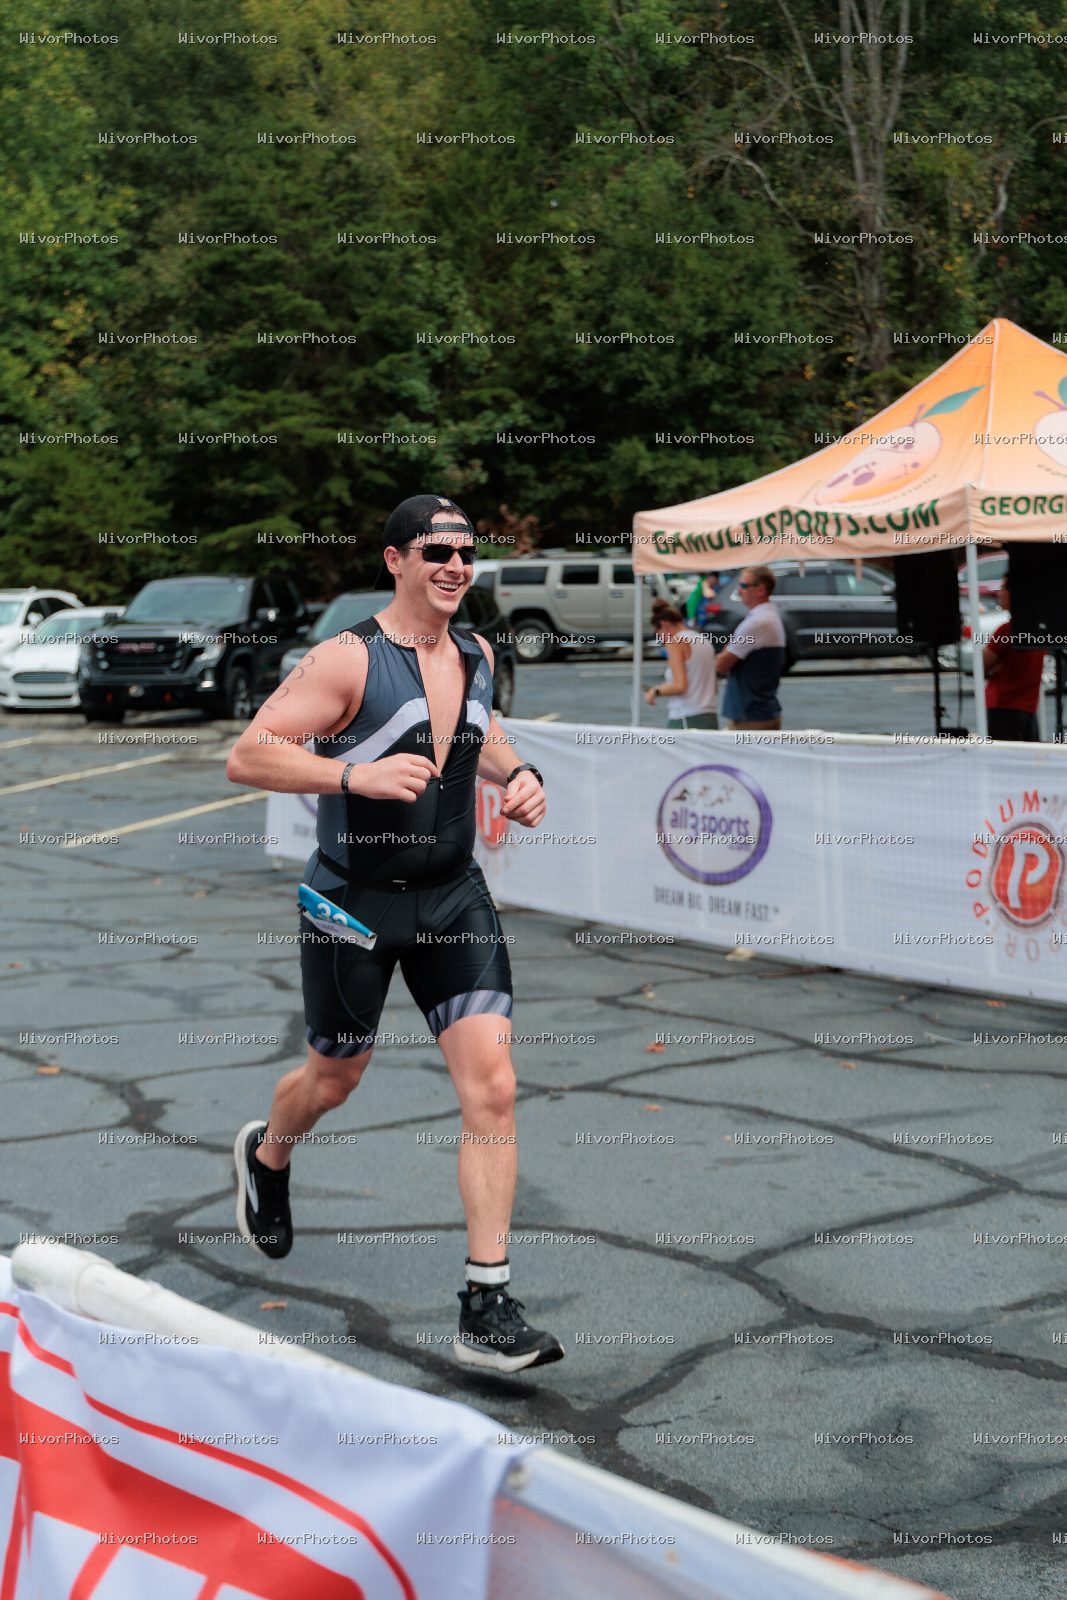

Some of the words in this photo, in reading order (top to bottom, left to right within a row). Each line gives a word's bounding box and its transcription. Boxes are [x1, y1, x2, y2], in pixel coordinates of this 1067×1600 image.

[966, 789, 1041, 920] PODIUM
[653, 885, 685, 907] DREAM
[707, 895, 742, 918] DREAM
